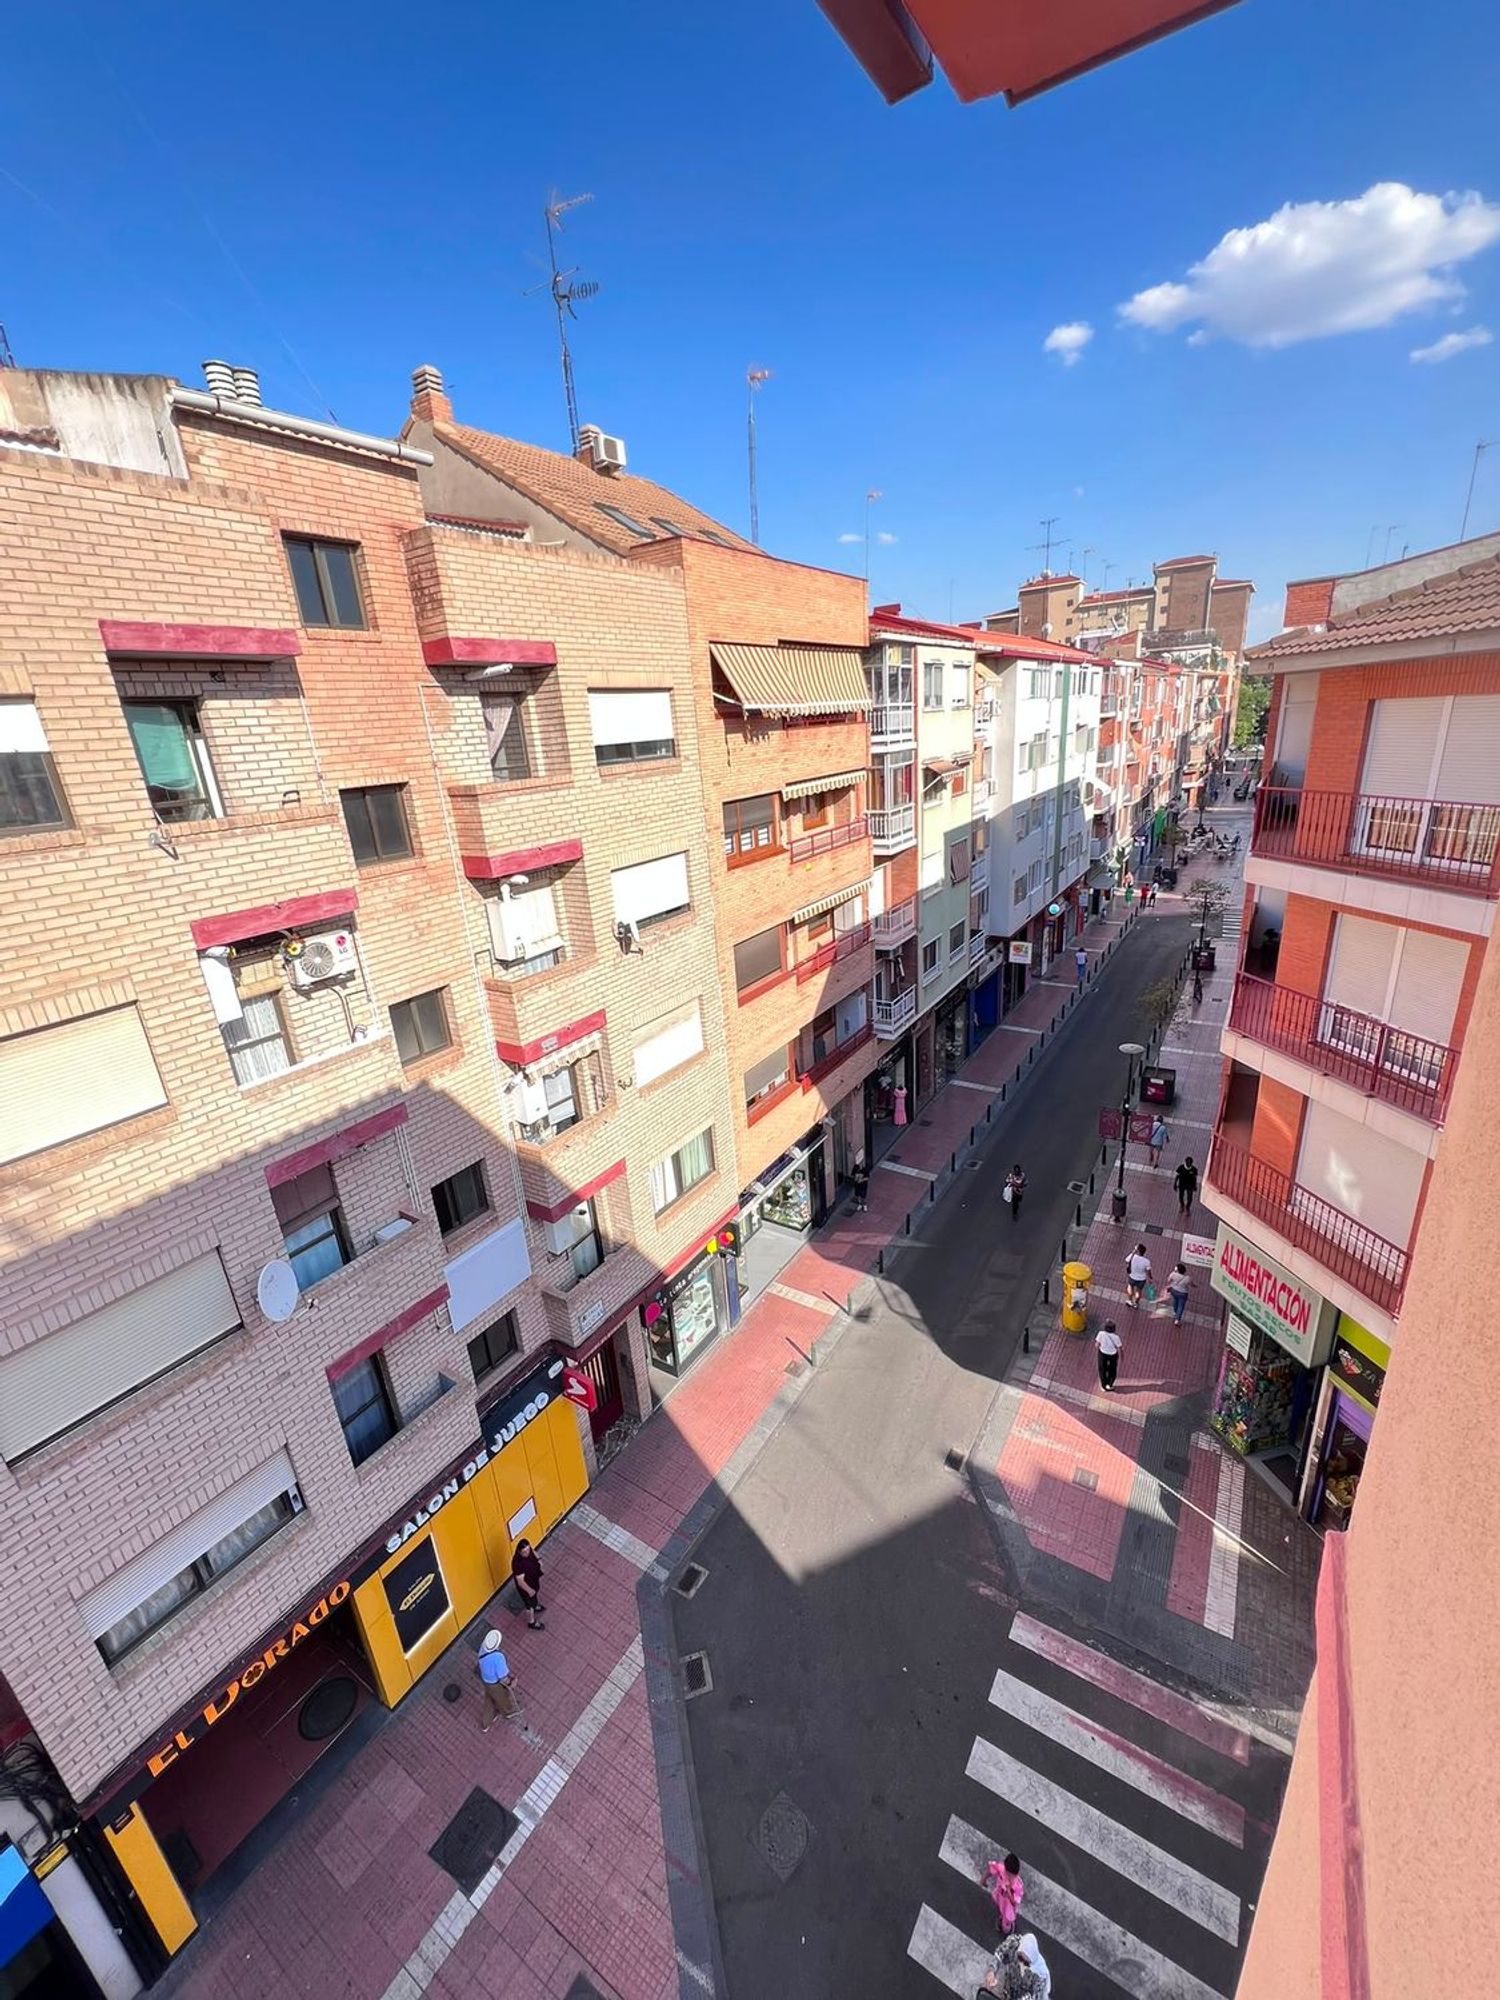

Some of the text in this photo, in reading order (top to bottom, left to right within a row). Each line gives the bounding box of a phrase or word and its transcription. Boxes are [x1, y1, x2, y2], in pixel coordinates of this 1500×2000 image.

[1220, 1240, 1312, 1335] ALIMENTACIÓN
[1221, 1275, 1261, 1313] FRUTOS
[1264, 1310, 1304, 1345] SECOS
[462, 1449, 490, 1482] DE
[490, 1391, 550, 1453] JUEGO
[147, 1731, 196, 1778] EL
